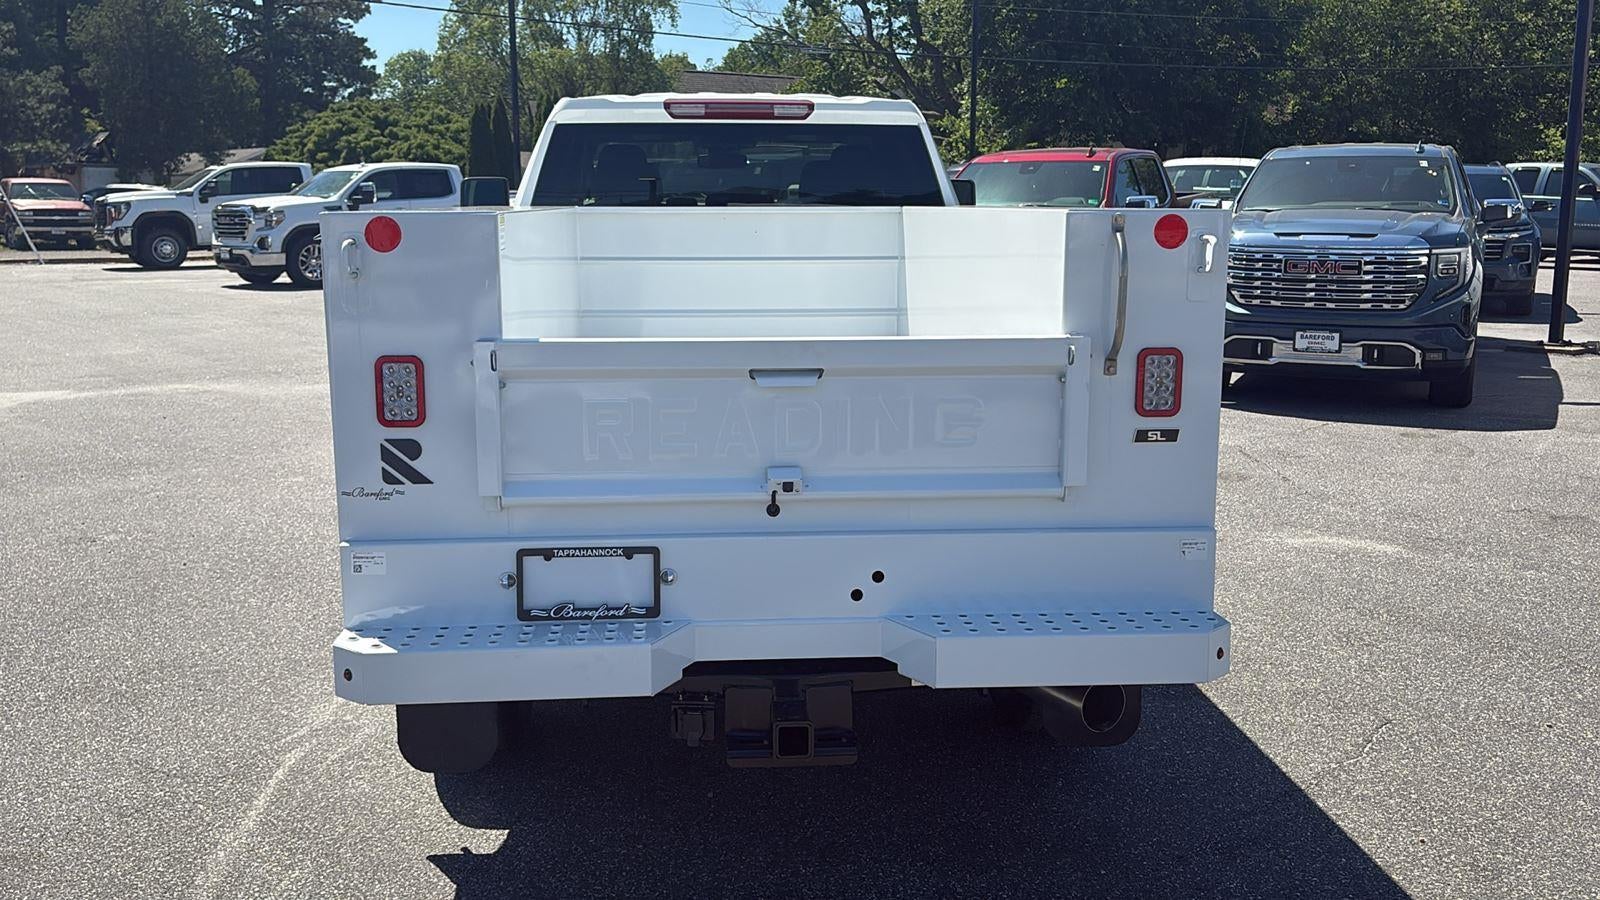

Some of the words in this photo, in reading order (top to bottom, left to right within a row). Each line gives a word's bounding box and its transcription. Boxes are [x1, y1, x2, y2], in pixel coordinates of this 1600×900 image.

[1286, 260, 1359, 275] GMC
[1300, 333, 1335, 341] BAREFORD
[583, 394, 986, 461] READING
[1147, 431, 1166, 441] SL
[351, 486, 396, 501] Bareford
[553, 548, 624, 557] TAPPAHANNOCK
[550, 602, 631, 621] Bareford
